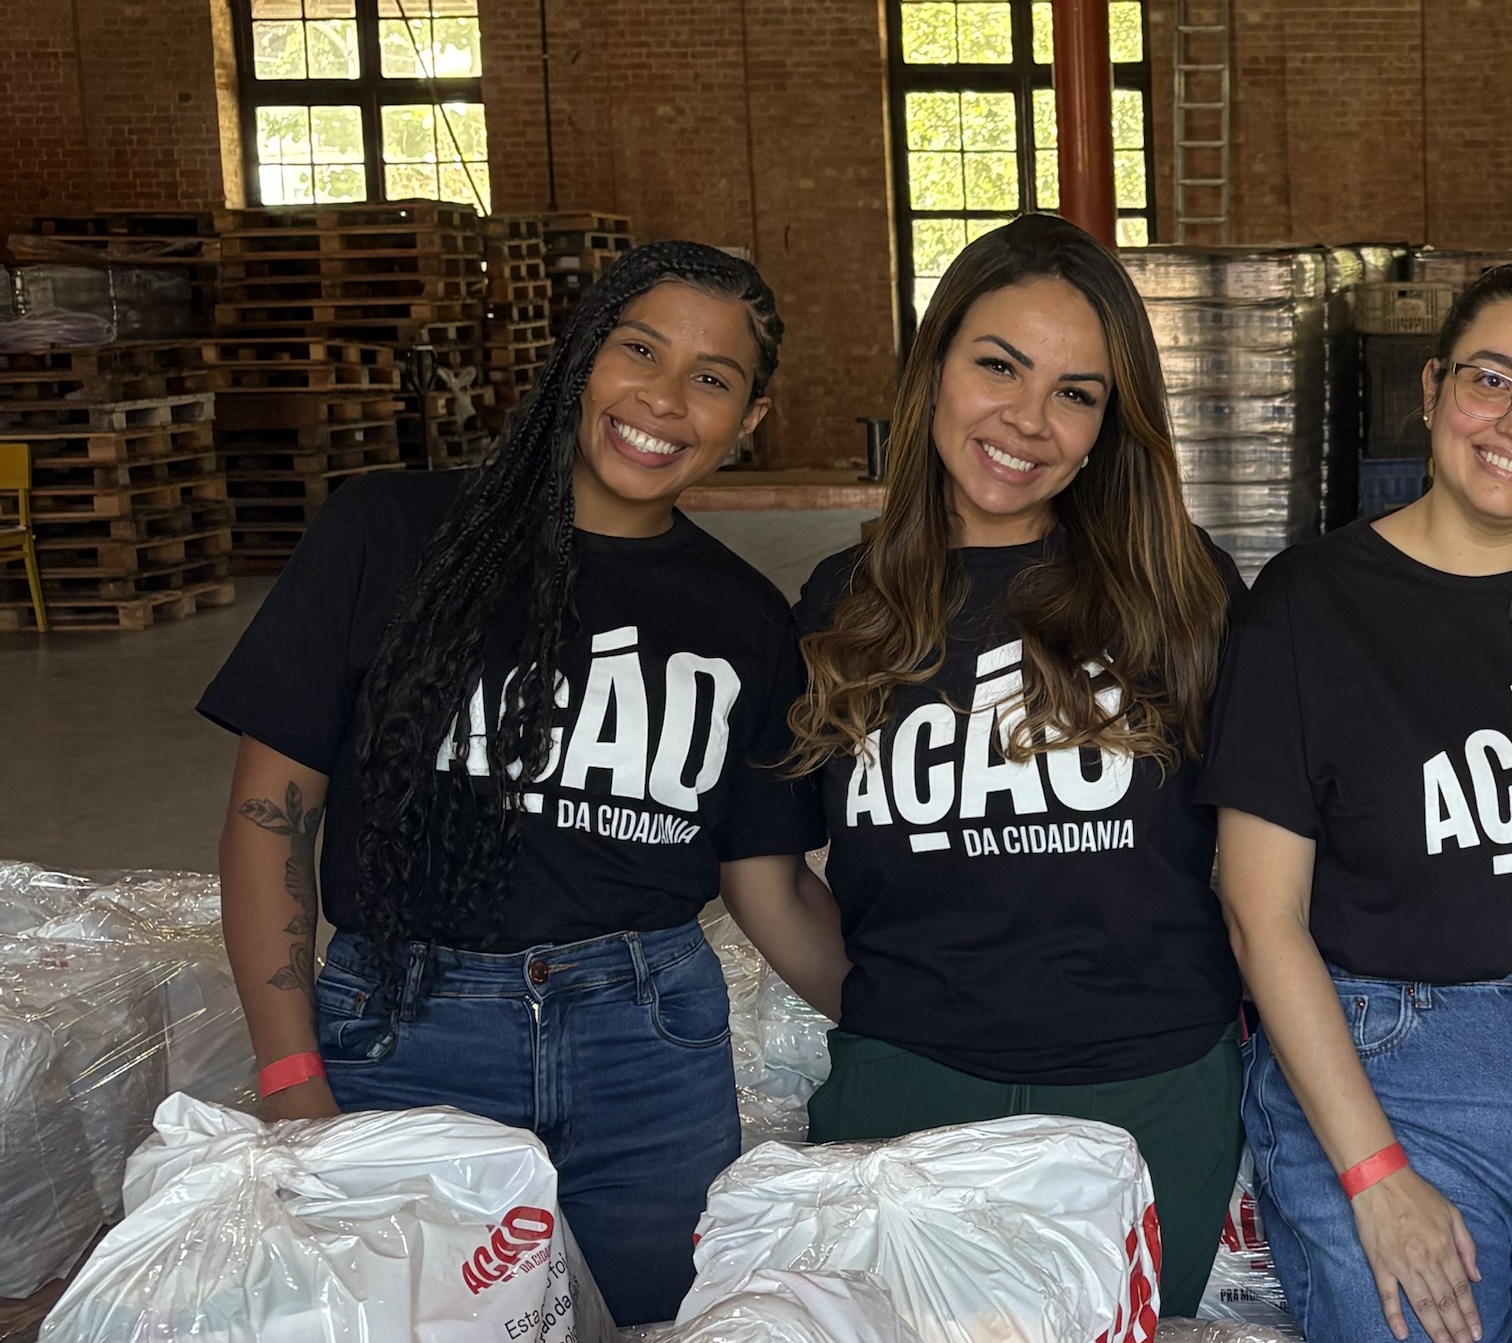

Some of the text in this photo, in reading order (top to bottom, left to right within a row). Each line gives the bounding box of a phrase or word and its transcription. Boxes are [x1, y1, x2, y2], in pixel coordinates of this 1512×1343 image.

[557, 799, 591, 832] DA
[962, 819, 1134, 857] DA CIDADANIA
[504, 1309, 542, 1340] Esta
